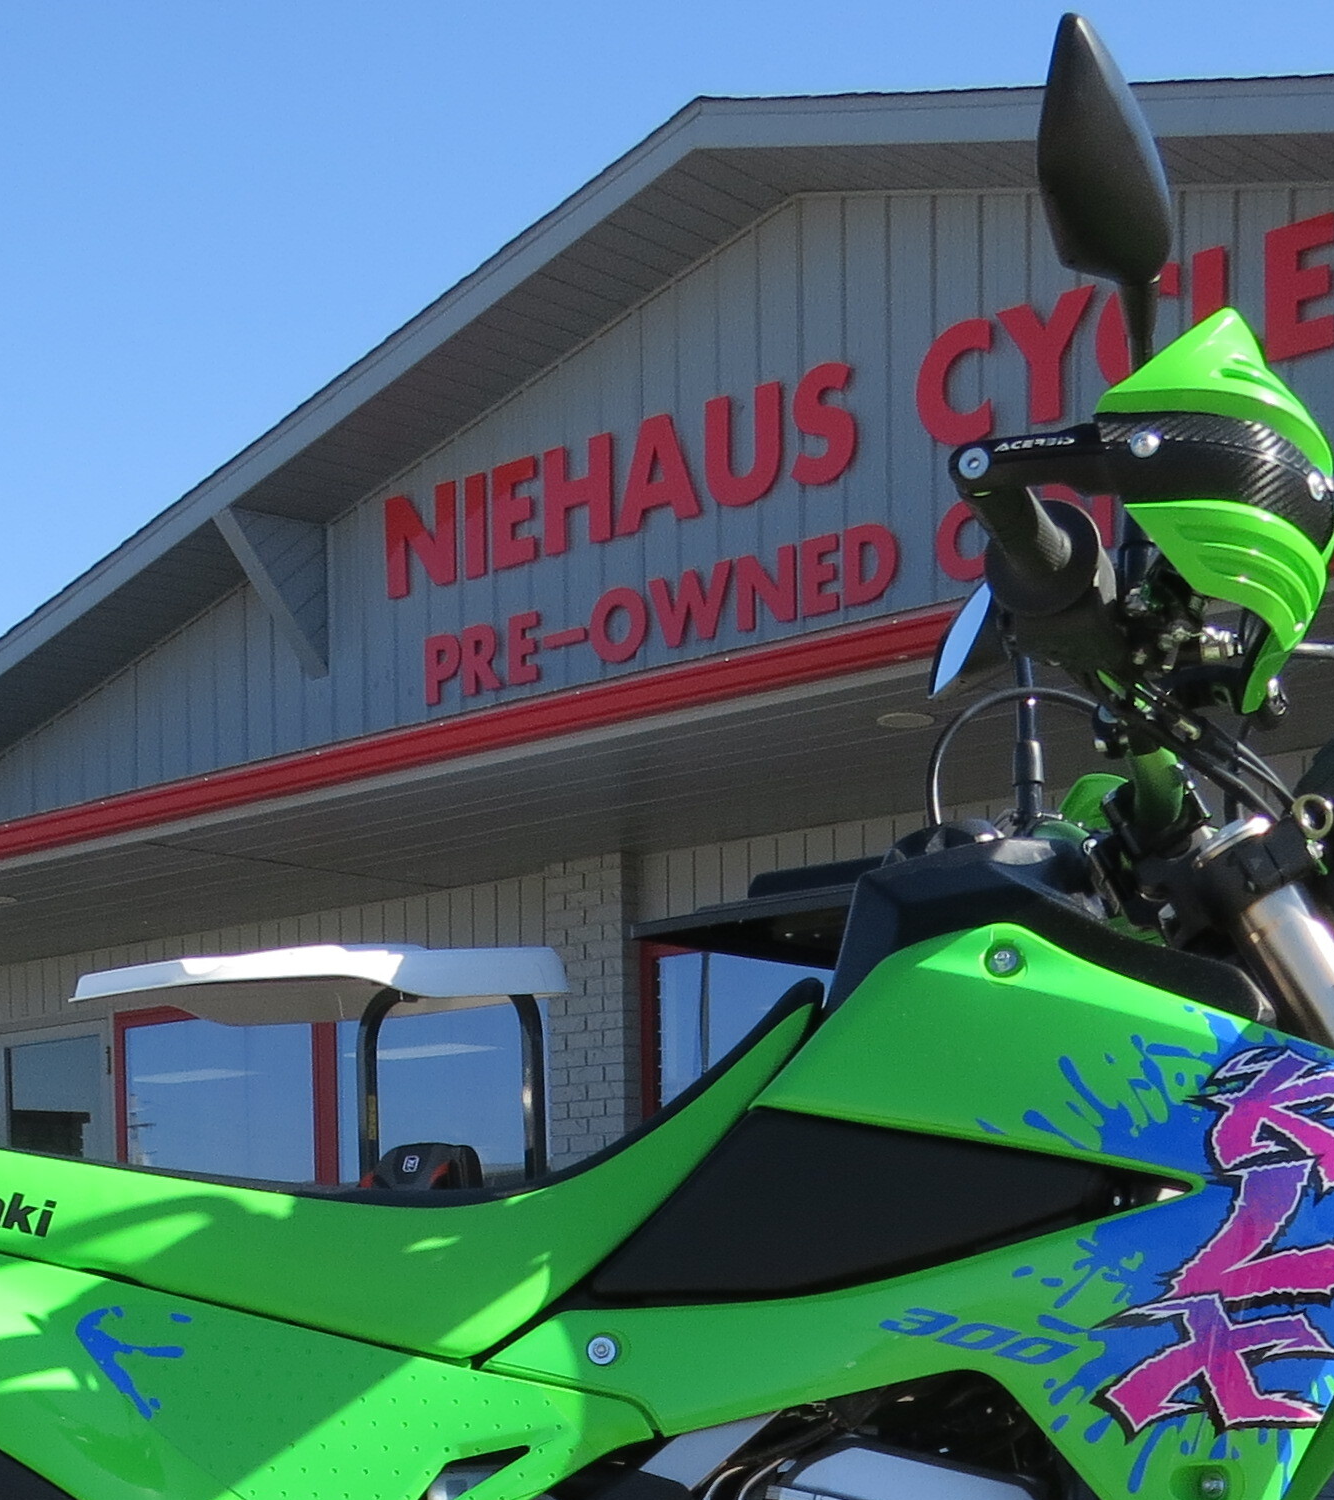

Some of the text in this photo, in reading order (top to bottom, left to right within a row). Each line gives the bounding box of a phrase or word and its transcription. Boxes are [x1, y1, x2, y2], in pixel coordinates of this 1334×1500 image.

[384, 362, 857, 598] NIEHAUS
[424, 524, 899, 707] PRE-OWNED
[879, 1307, 1079, 1365] 300
